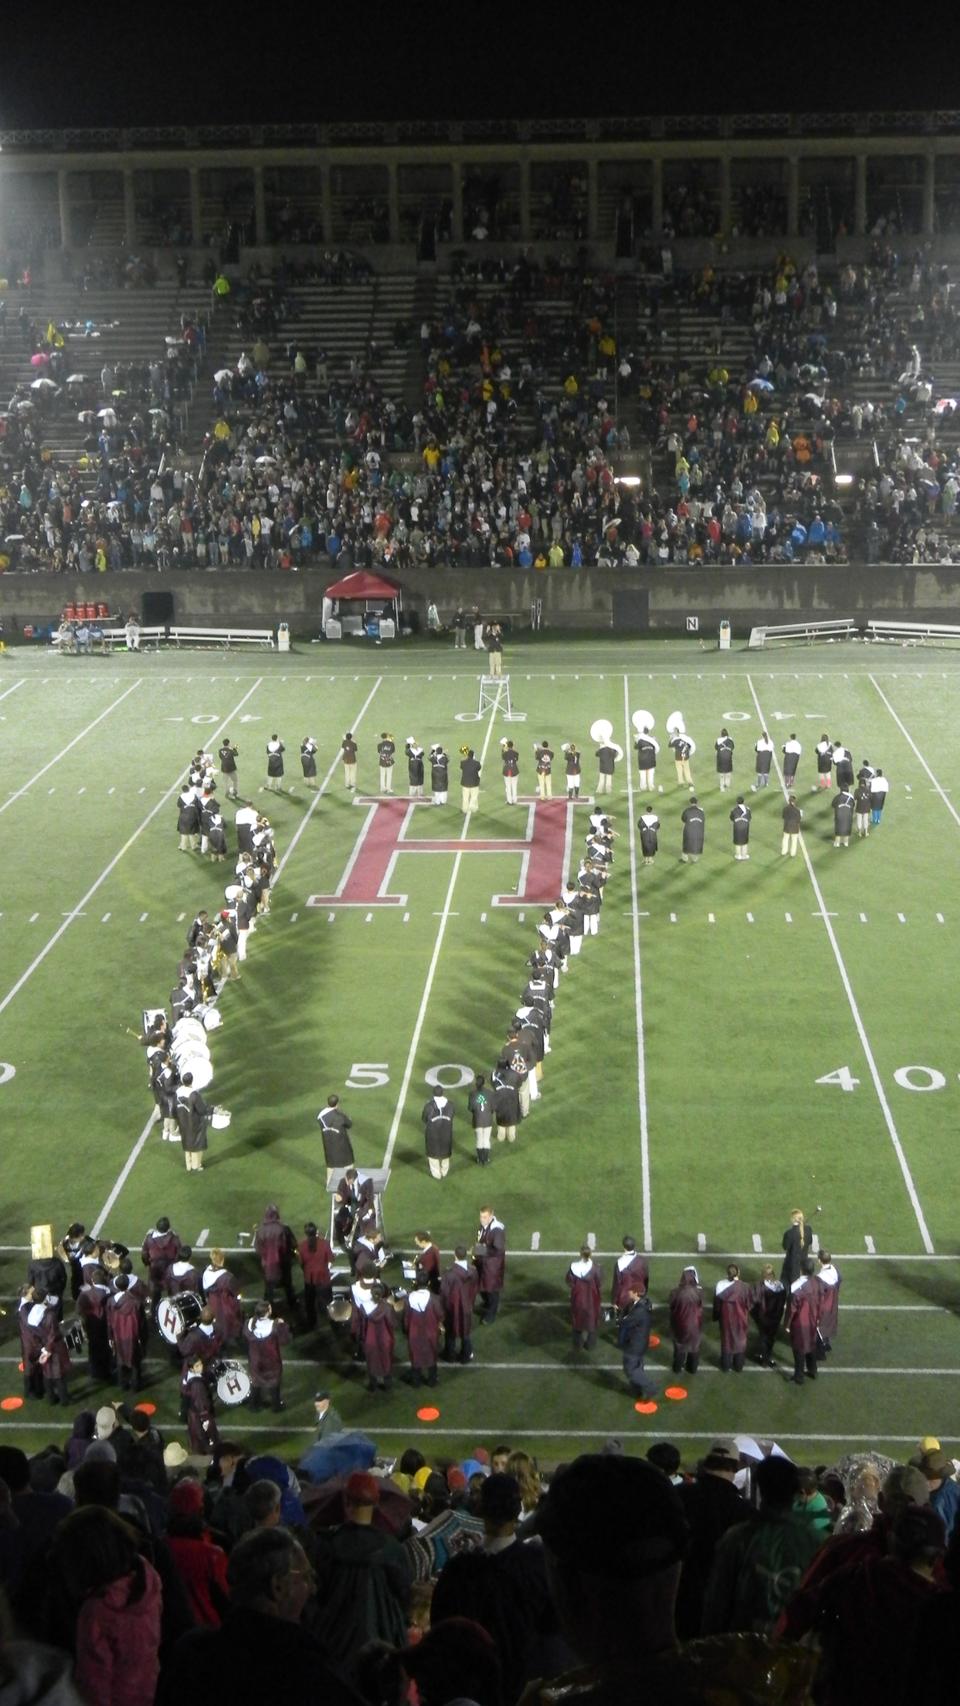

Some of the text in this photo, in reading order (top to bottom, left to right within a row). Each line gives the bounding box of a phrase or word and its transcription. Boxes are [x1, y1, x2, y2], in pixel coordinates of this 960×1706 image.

[687, 617, 697, 630] N
[306, 796, 595, 906] H
[163, 1309, 177, 1335] H
[226, 1379, 242, 1396] H
